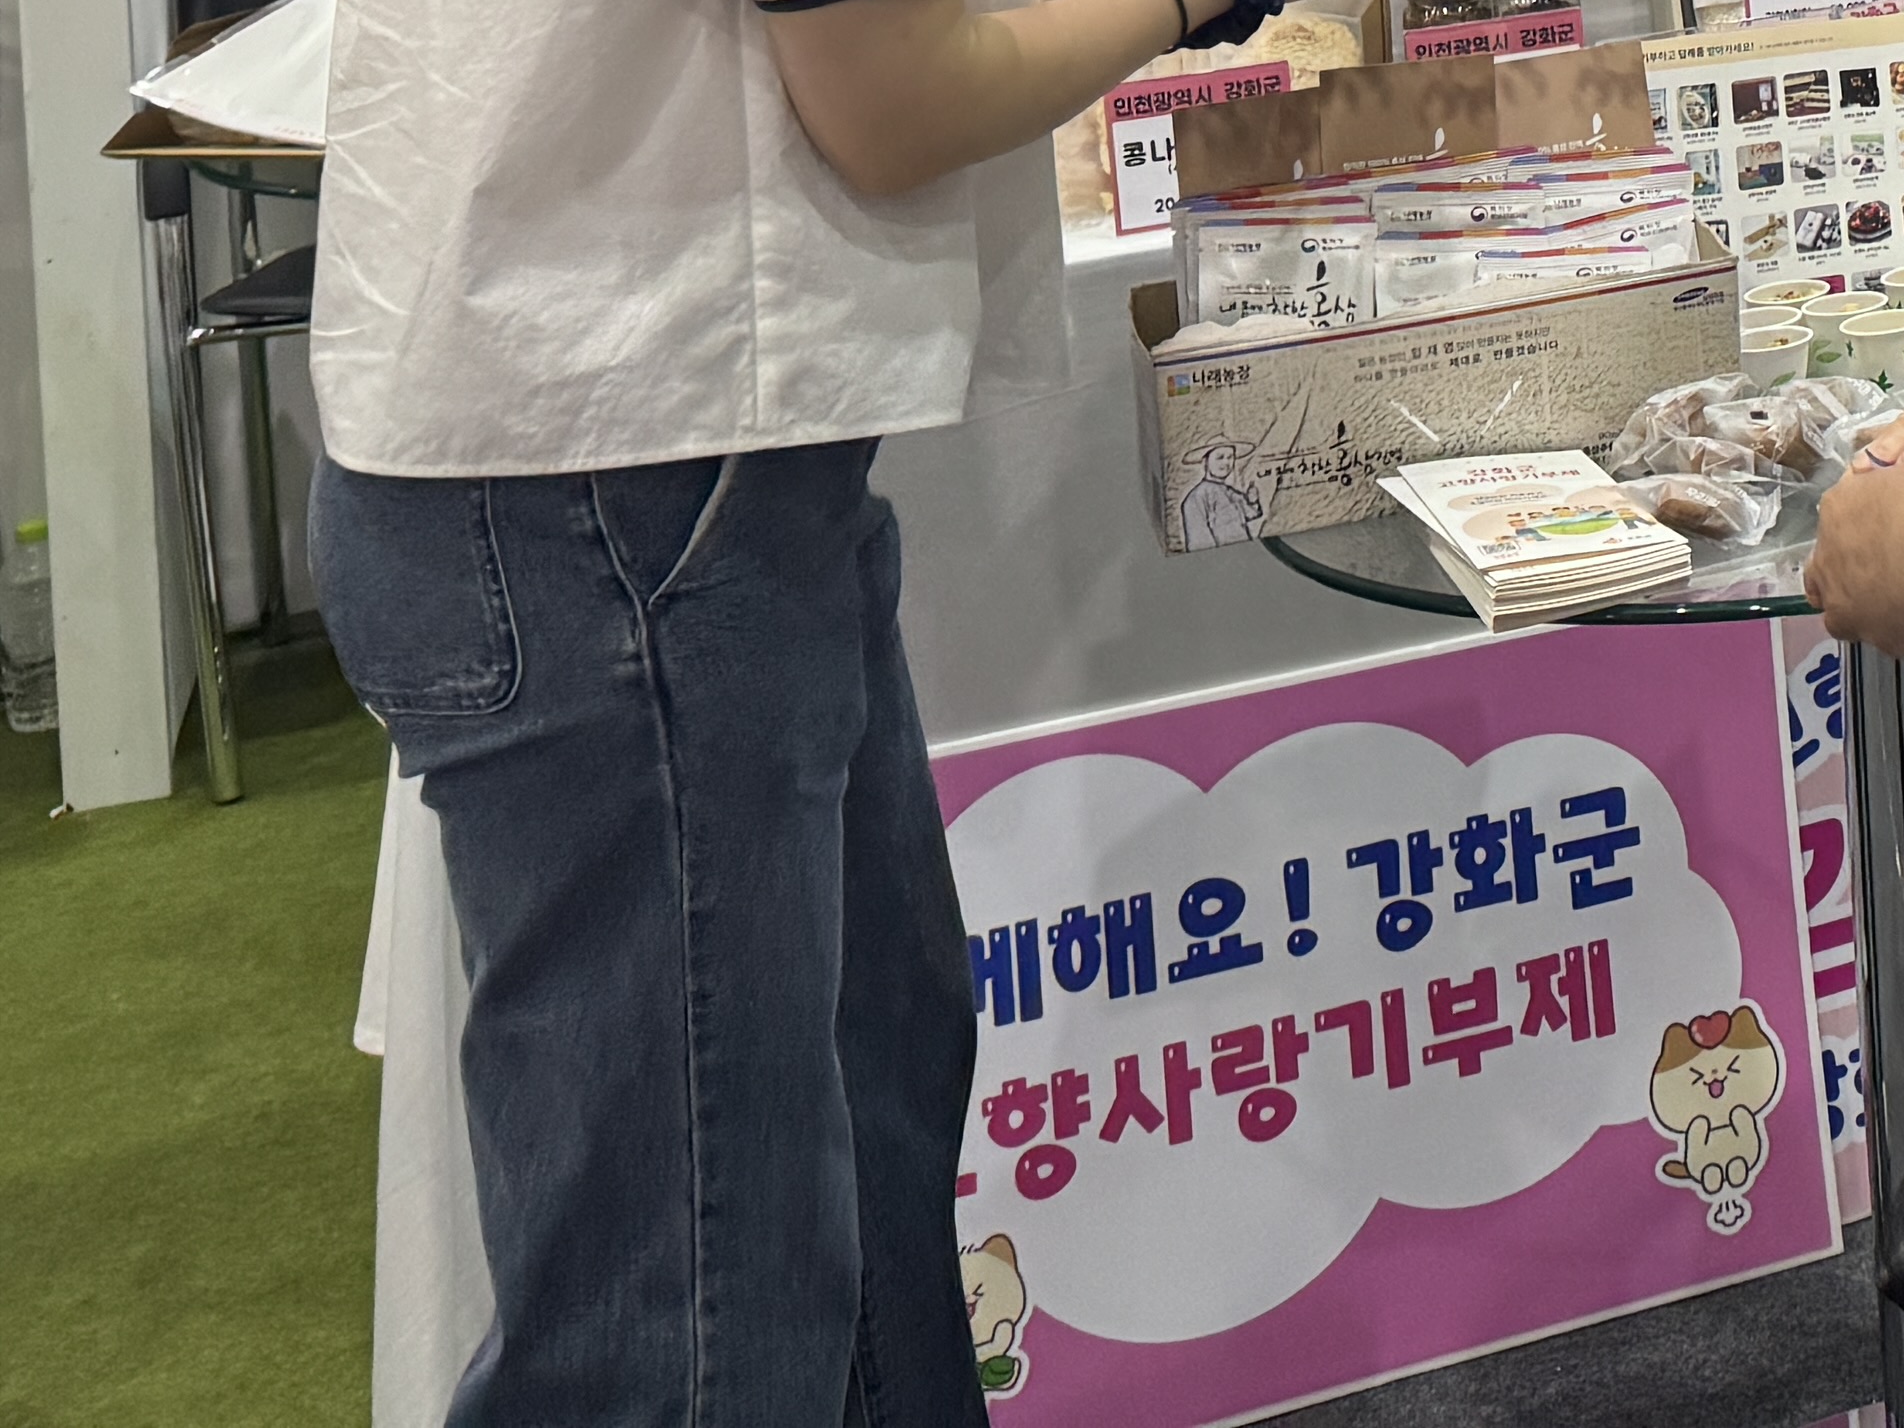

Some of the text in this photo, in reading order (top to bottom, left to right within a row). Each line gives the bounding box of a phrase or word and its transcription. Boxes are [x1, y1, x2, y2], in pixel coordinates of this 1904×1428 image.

[1415, 23, 1574, 60] 인천광역시 강화군
[1114, 75, 1281, 117] 인천광역시 강화군
[1438, 468, 1581, 489] 고향사랑기부제
[1346, 785, 1641, 955] 강화군
[956, 938, 1617, 1201] 향사랑기부제
